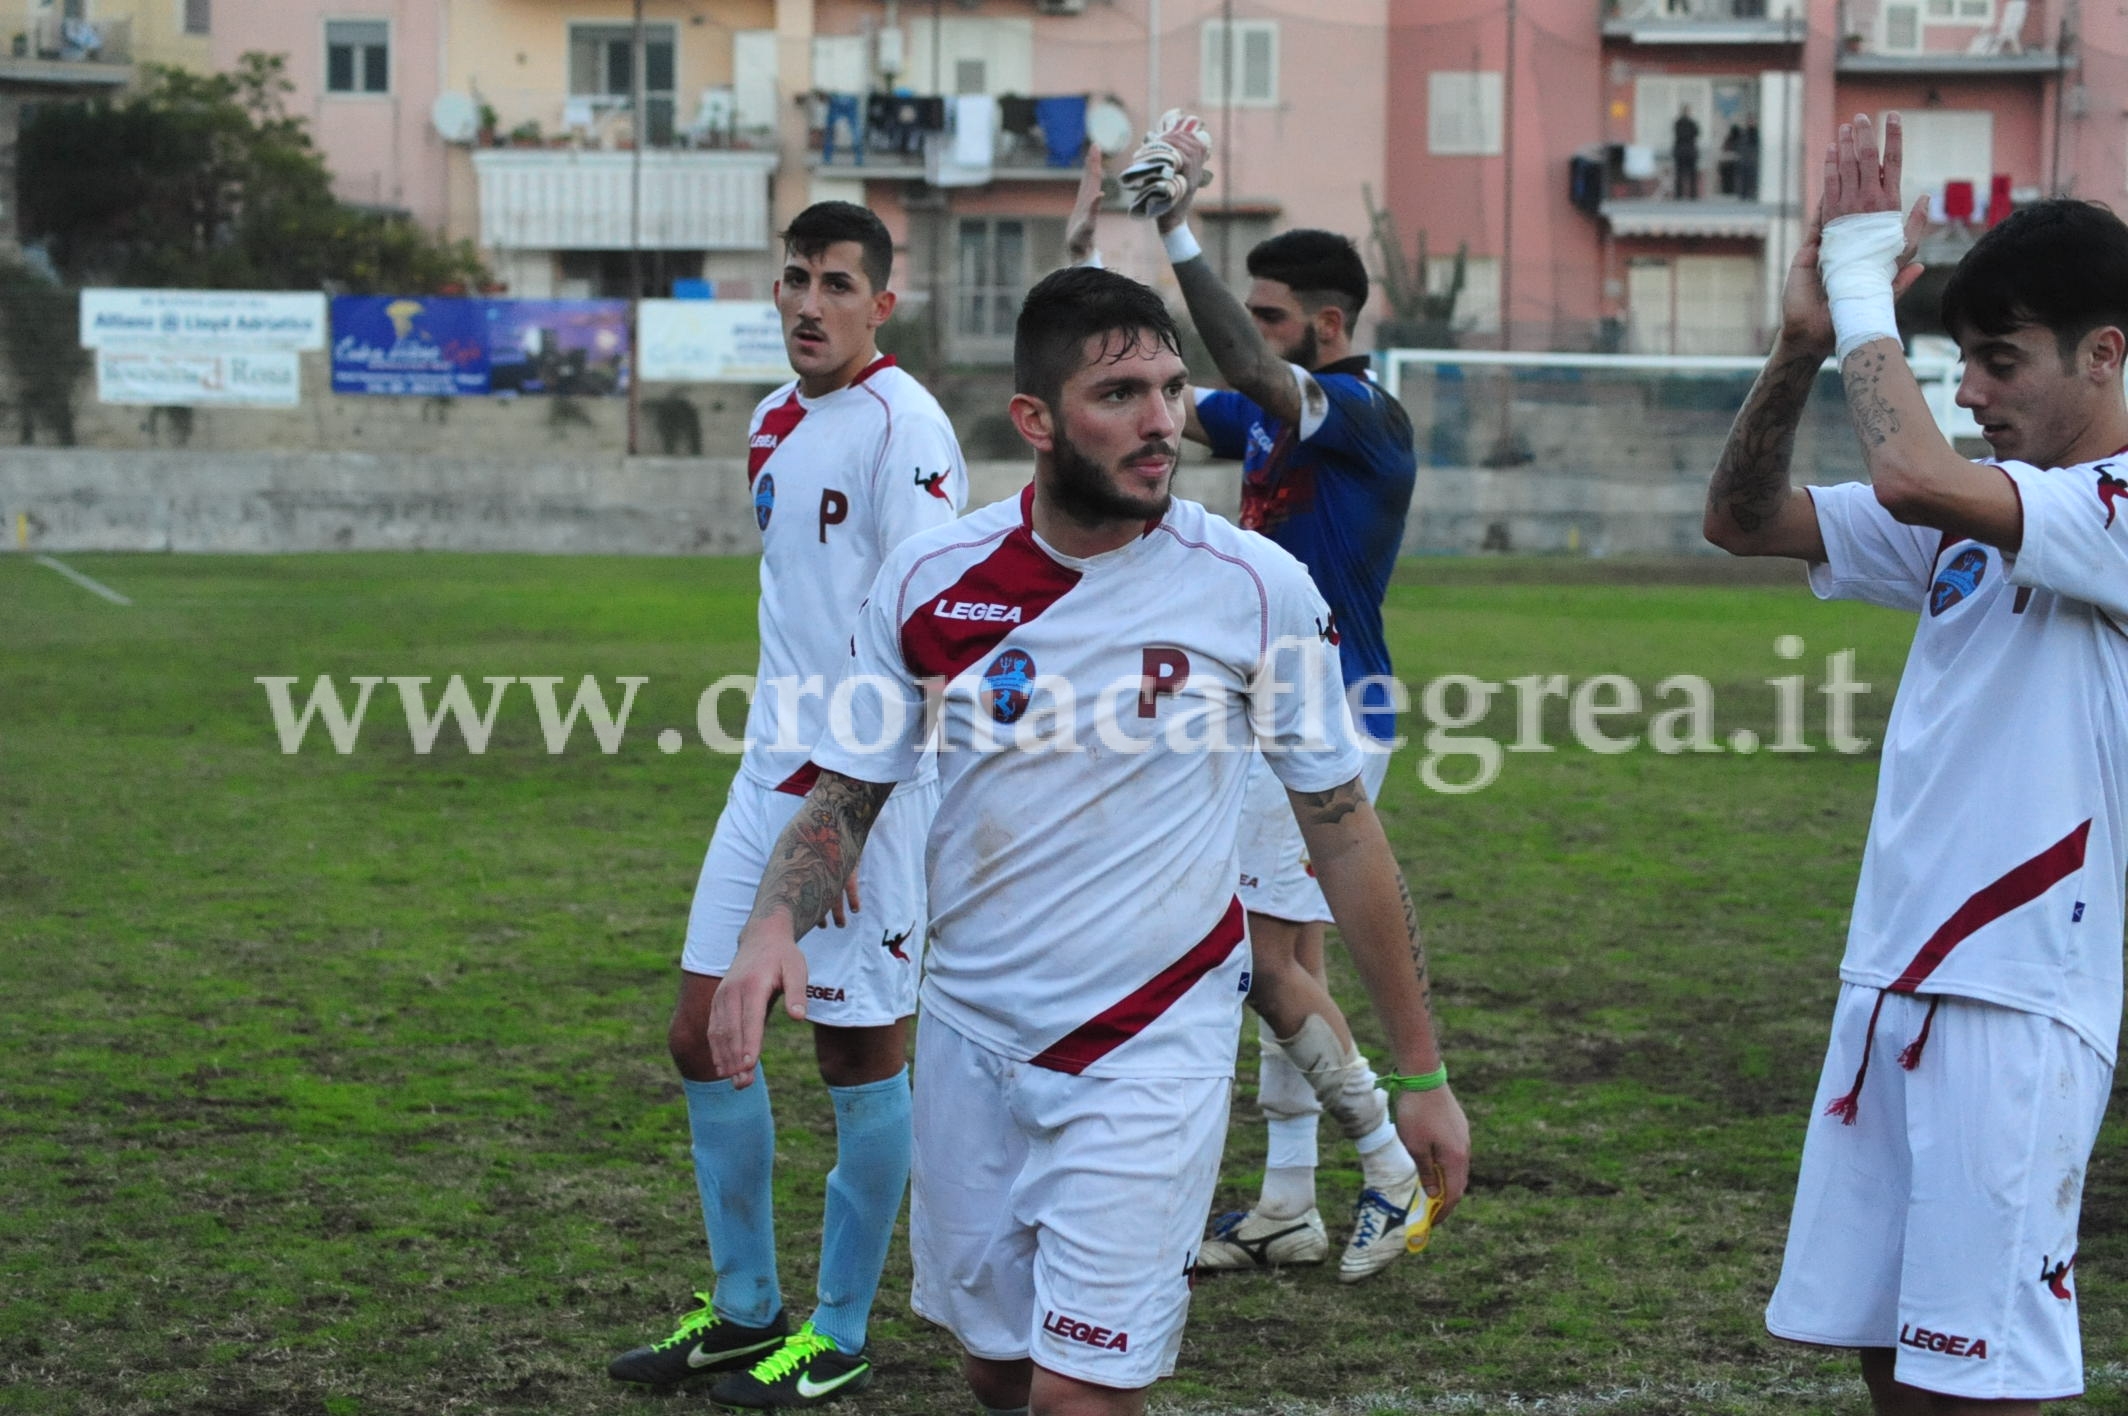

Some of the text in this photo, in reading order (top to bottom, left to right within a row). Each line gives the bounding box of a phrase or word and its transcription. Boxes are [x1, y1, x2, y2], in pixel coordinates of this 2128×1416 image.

[819, 487, 849, 545] P
[933, 599, 1022, 624] LEGEA
[1137, 647, 1191, 719] P
[806, 985, 846, 1002] EGEA
[1042, 1310, 1129, 1353] LEGEA
[1899, 1323, 1987, 1360] LEGEA
